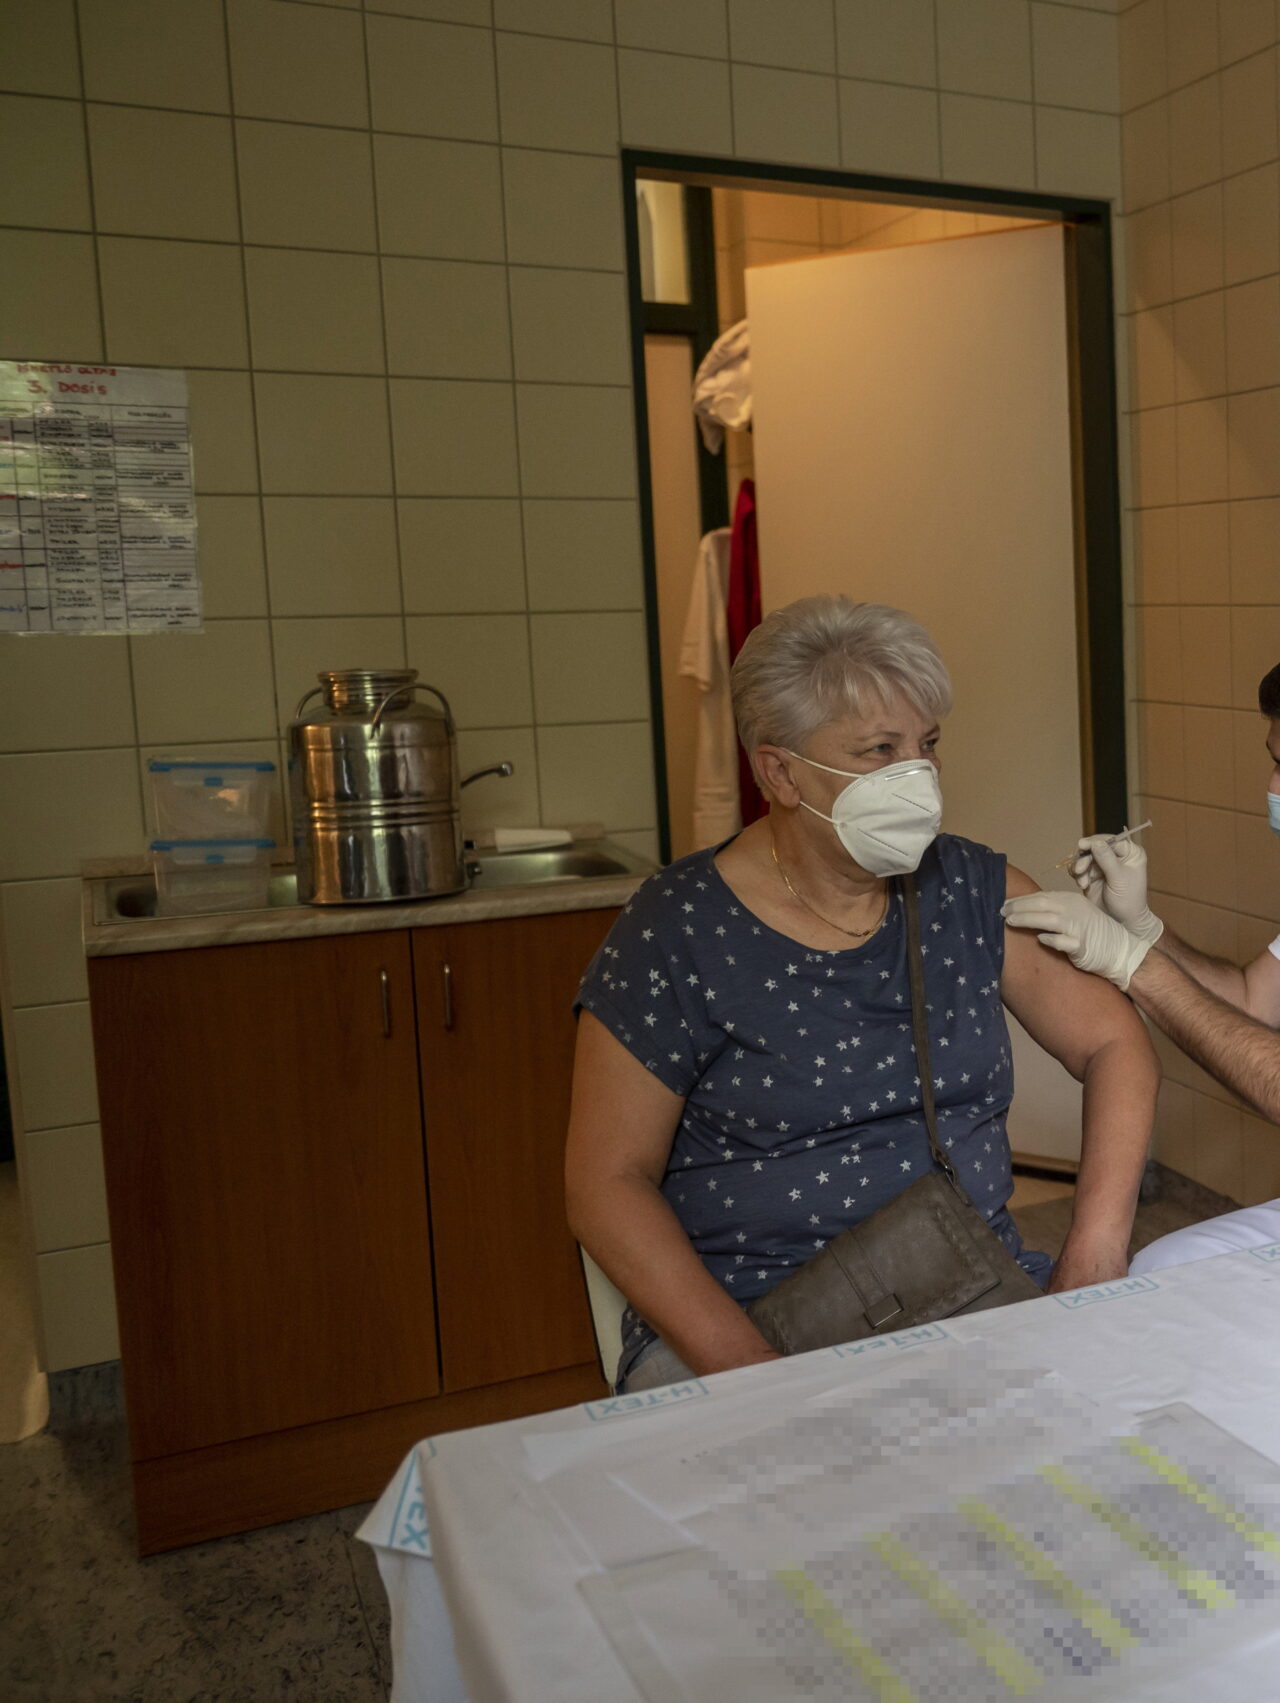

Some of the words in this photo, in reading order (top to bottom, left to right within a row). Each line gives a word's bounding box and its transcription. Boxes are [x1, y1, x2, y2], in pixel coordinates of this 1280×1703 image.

[27, 380, 48, 394] 3.
[1065, 1279, 1146, 1304] H-TEX
[600, 1384, 693, 1414] H-TEX
